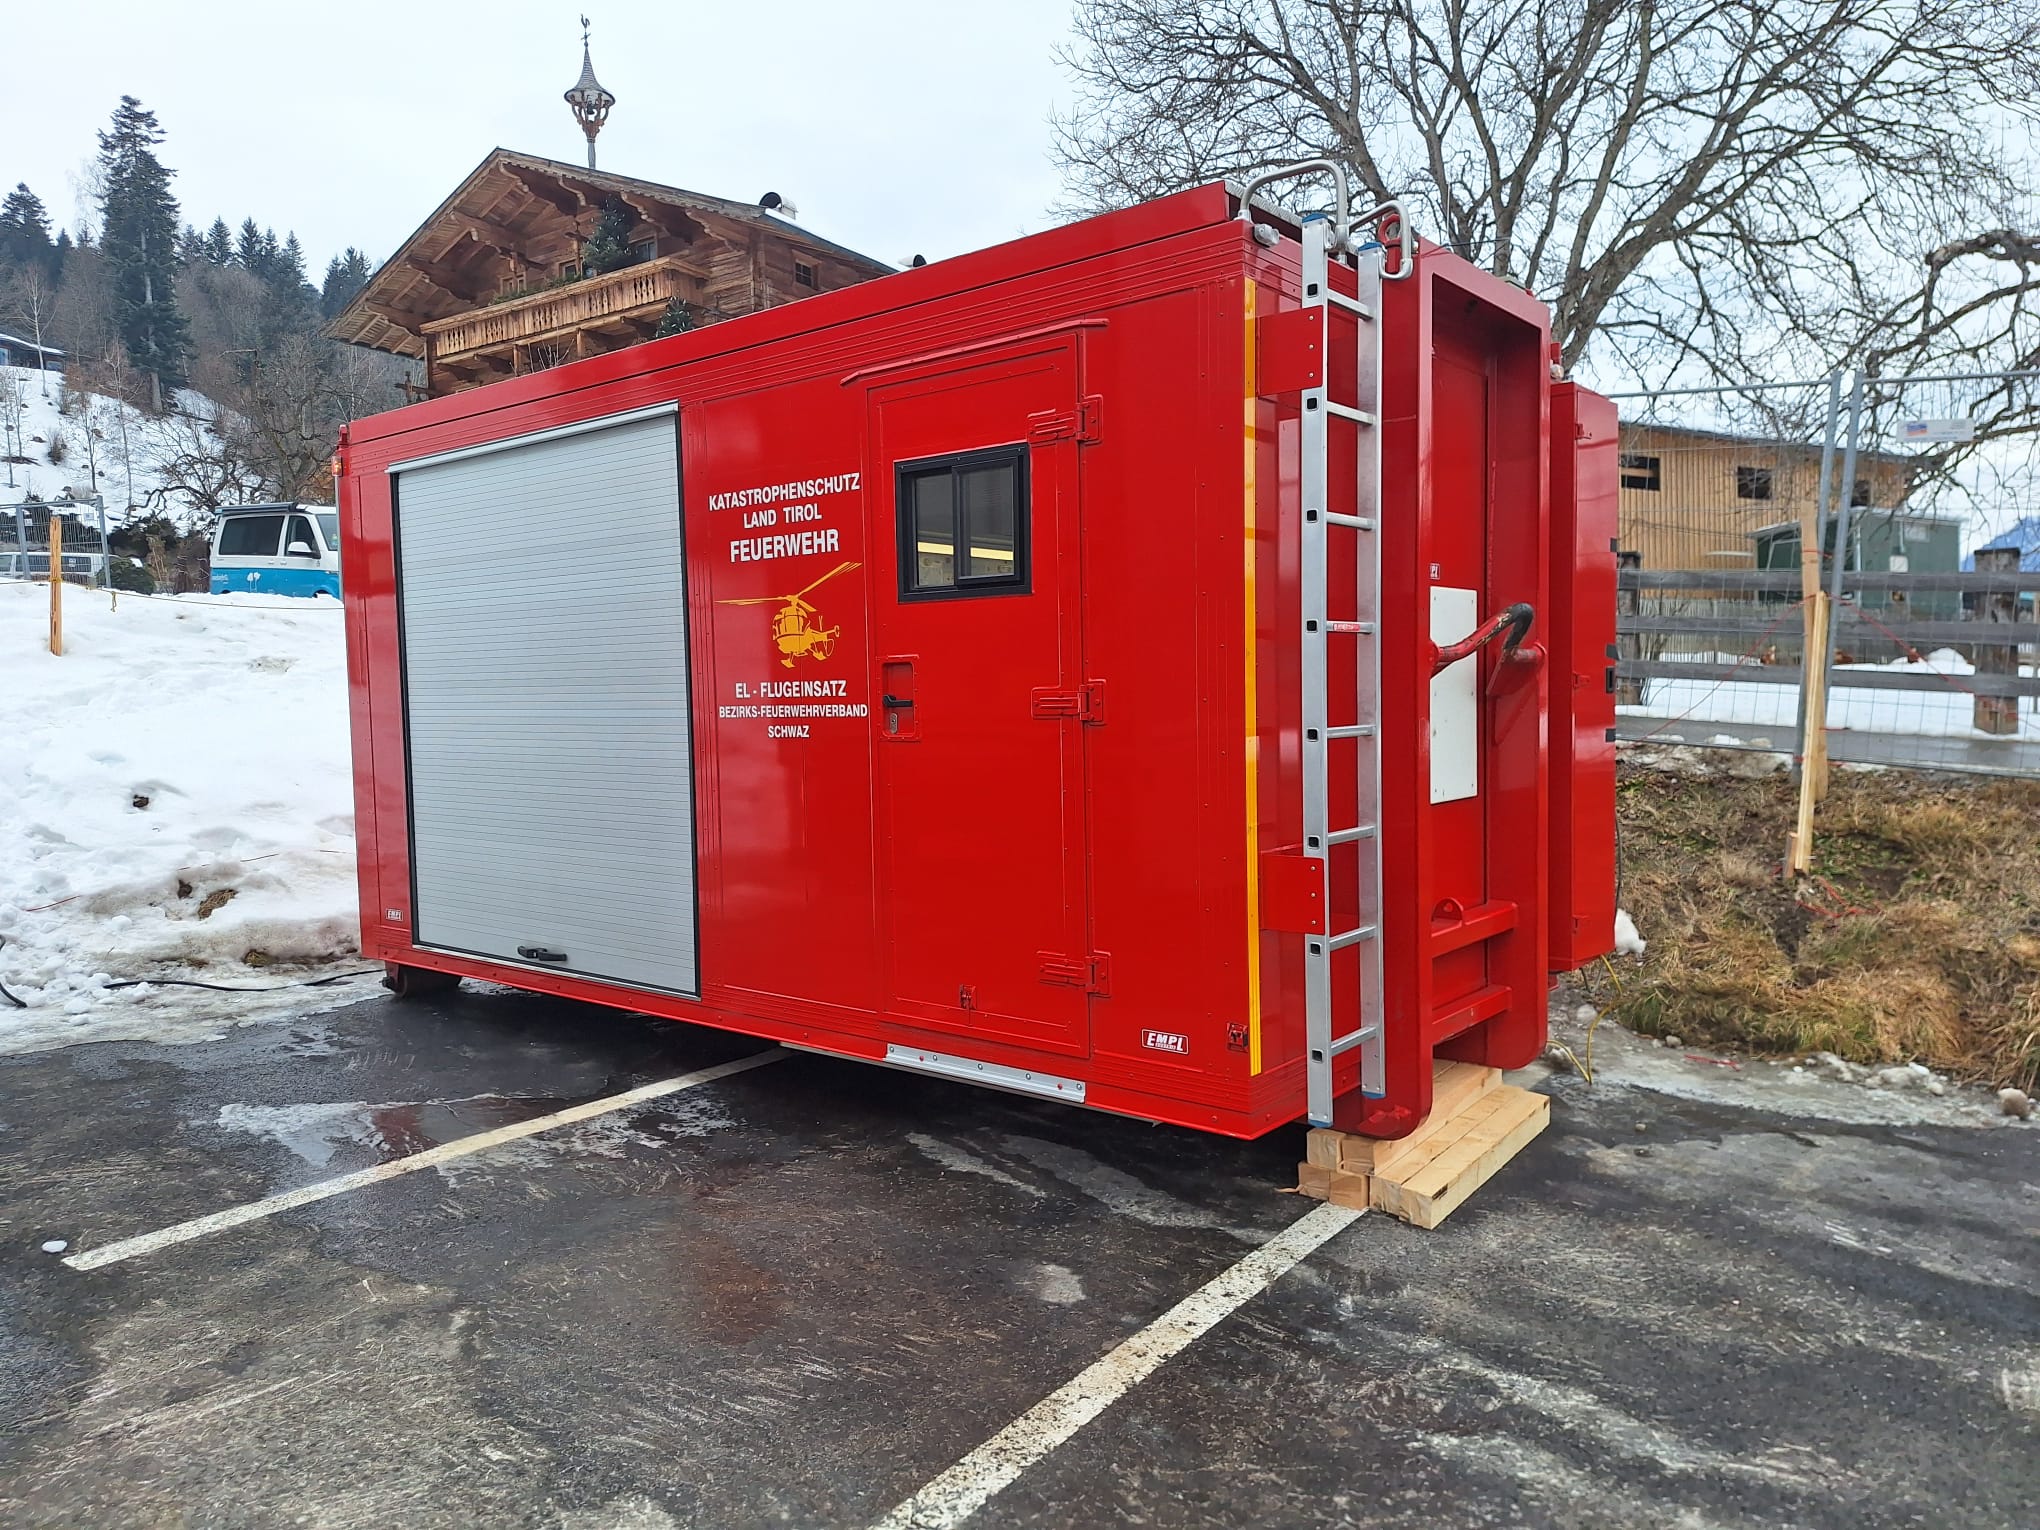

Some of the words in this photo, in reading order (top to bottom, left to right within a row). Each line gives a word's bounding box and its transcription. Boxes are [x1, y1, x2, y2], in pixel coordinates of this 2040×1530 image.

[708, 472, 861, 512] KATASTROPHENSCHUTZ
[743, 509, 777, 529] LAND
[783, 503, 822, 523] TIROL
[730, 528, 839, 563] FEUERWEHR
[735, 682, 750, 698] EL
[760, 680, 847, 698] FLUGEINSATZ
[718, 703, 868, 719] BEZIRKS-FEUERWEHRVERBAND
[767, 725, 810, 738] SCHWAZ
[1147, 1032, 1183, 1051] EMPL
